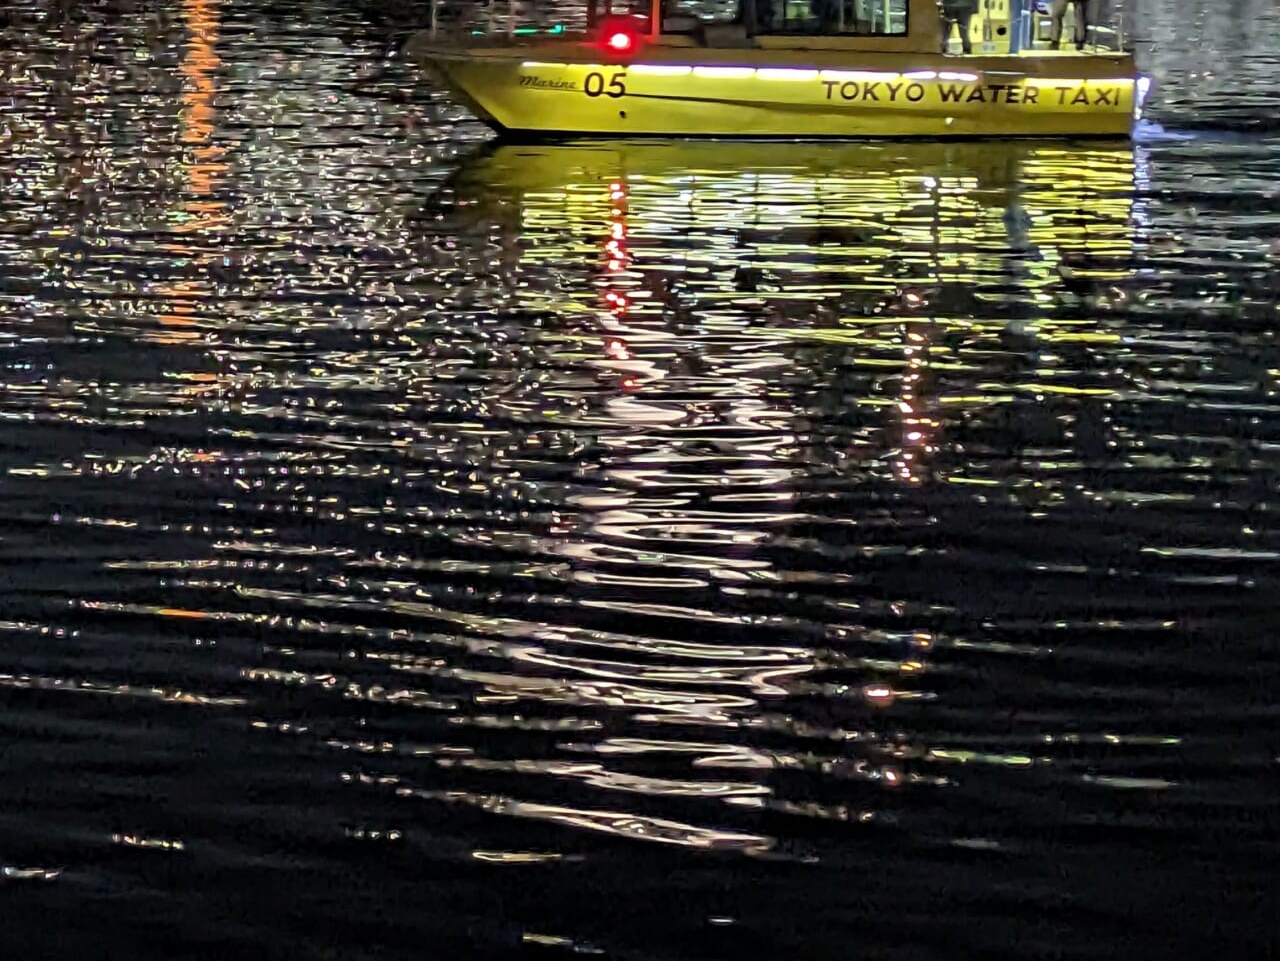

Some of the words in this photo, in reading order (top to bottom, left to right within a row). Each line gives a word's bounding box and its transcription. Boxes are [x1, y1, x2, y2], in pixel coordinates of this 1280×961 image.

[584, 72, 627, 98] 05
[822, 80, 925, 102] TOKYO
[937, 83, 1040, 104] WATER
[1054, 86, 1121, 106] TAXI
